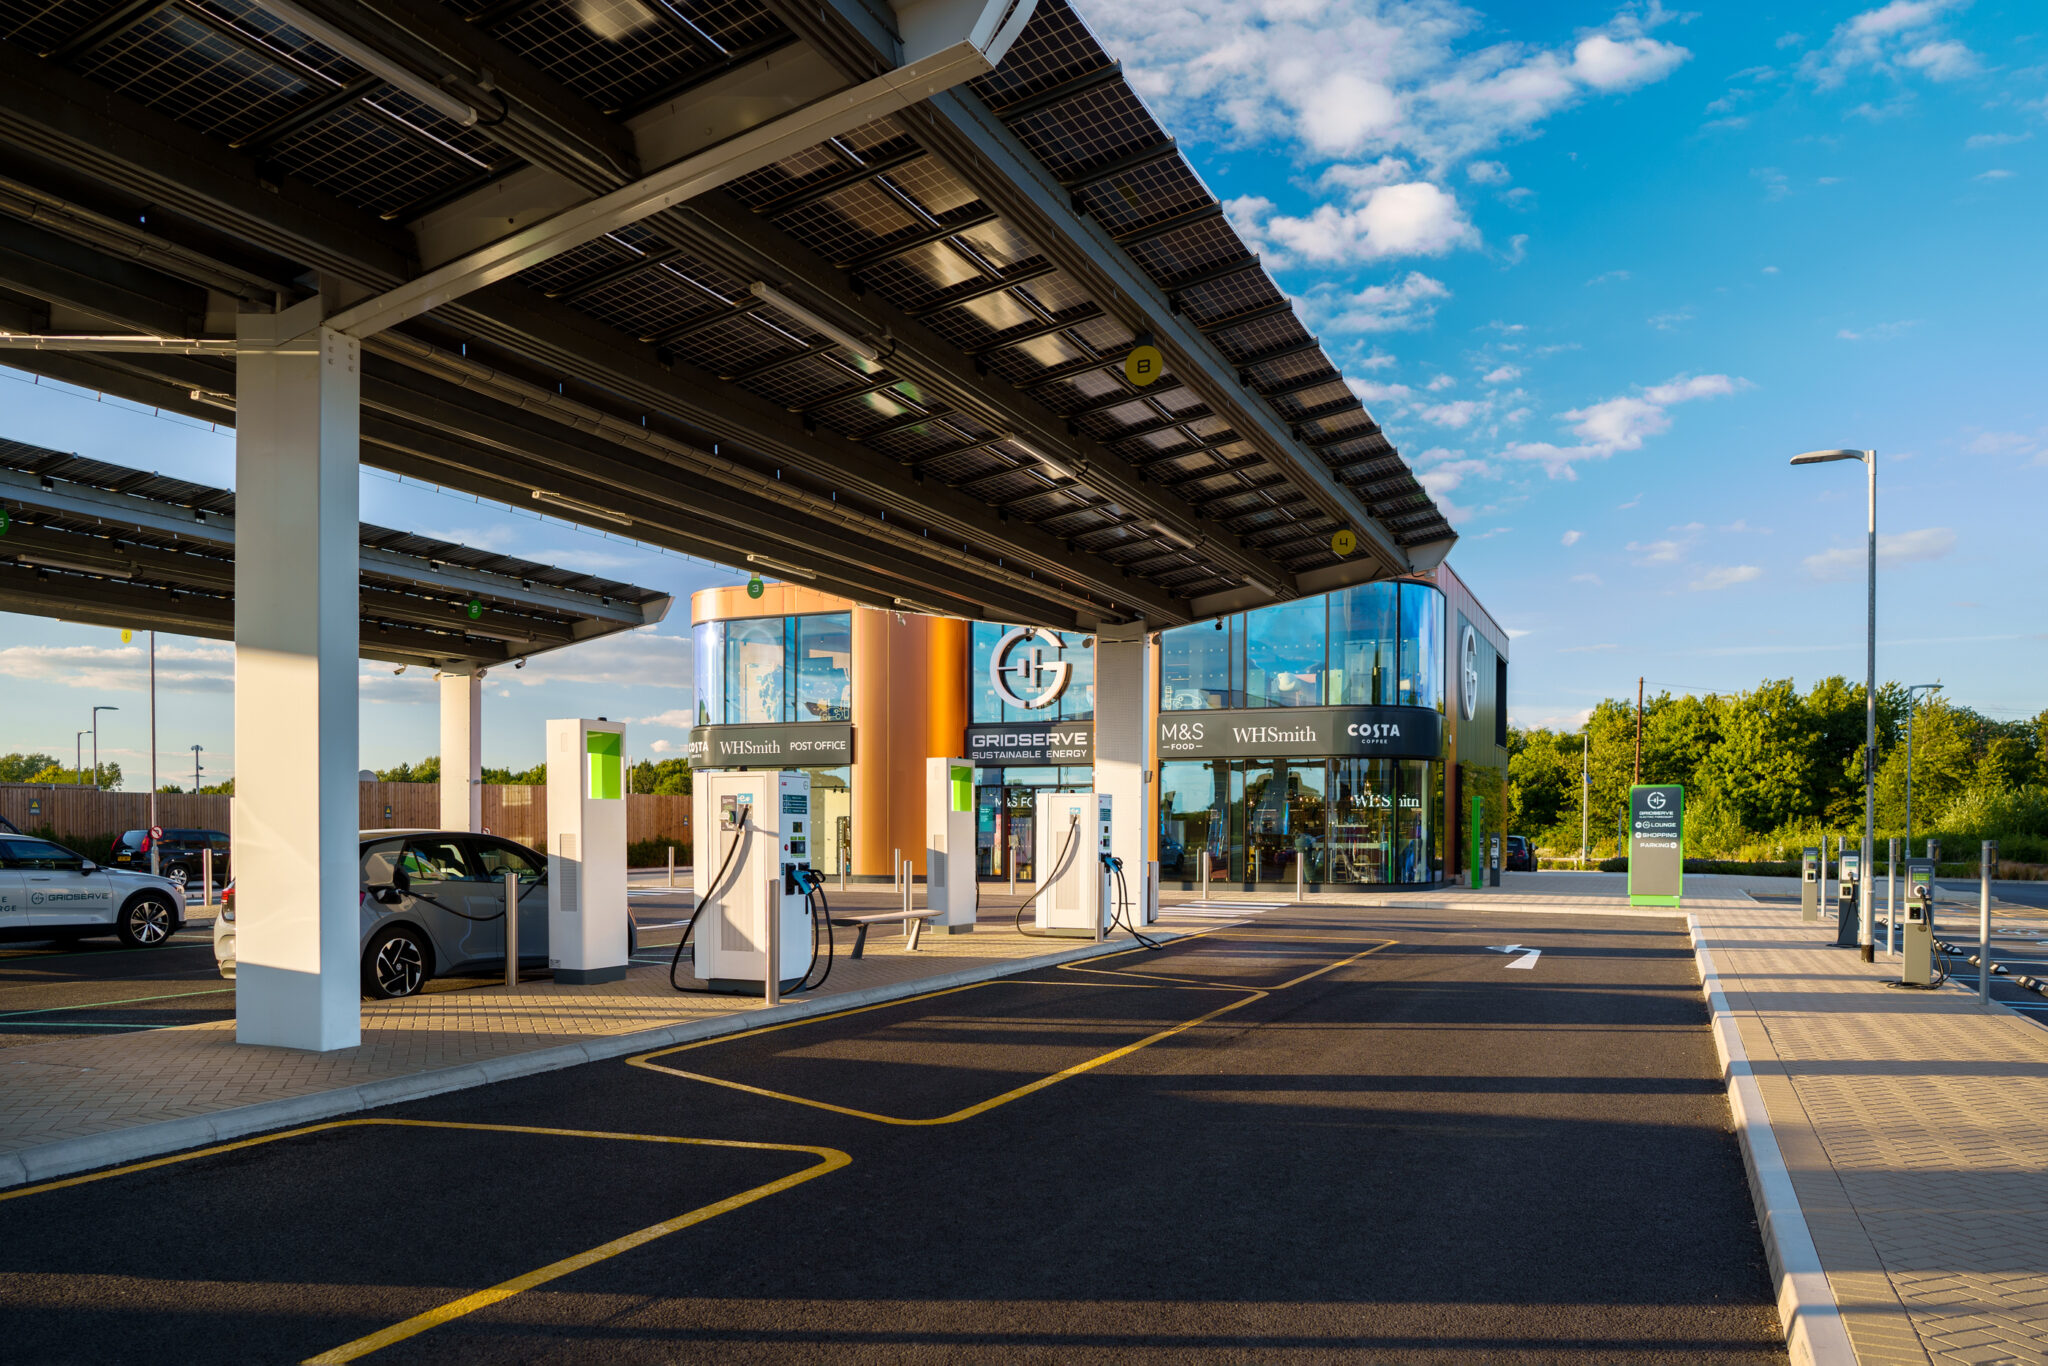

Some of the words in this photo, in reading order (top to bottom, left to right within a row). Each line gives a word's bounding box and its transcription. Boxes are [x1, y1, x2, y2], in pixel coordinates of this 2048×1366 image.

[1137, 359, 1150, 373] 8
[1339, 537, 1348, 547] 4
[751, 584, 760, 593] 3
[471, 605, 478, 613] 2
[1161, 722, 1204, 741] M&S
[1232, 725, 1317, 743] WHSmith
[1347, 723, 1400, 738] COSTA
[790, 741, 812, 751] POST
[814, 740, 846, 751] OFFICE
[972, 732, 1088, 747] GRIDSERVE
[720, 740, 781, 755] WHSmith
[972, 750, 1041, 759] SUSTAINABLE
[1046, 749, 1087, 758] ENERGY
[48, 892, 109, 902] GRIDSERVE
